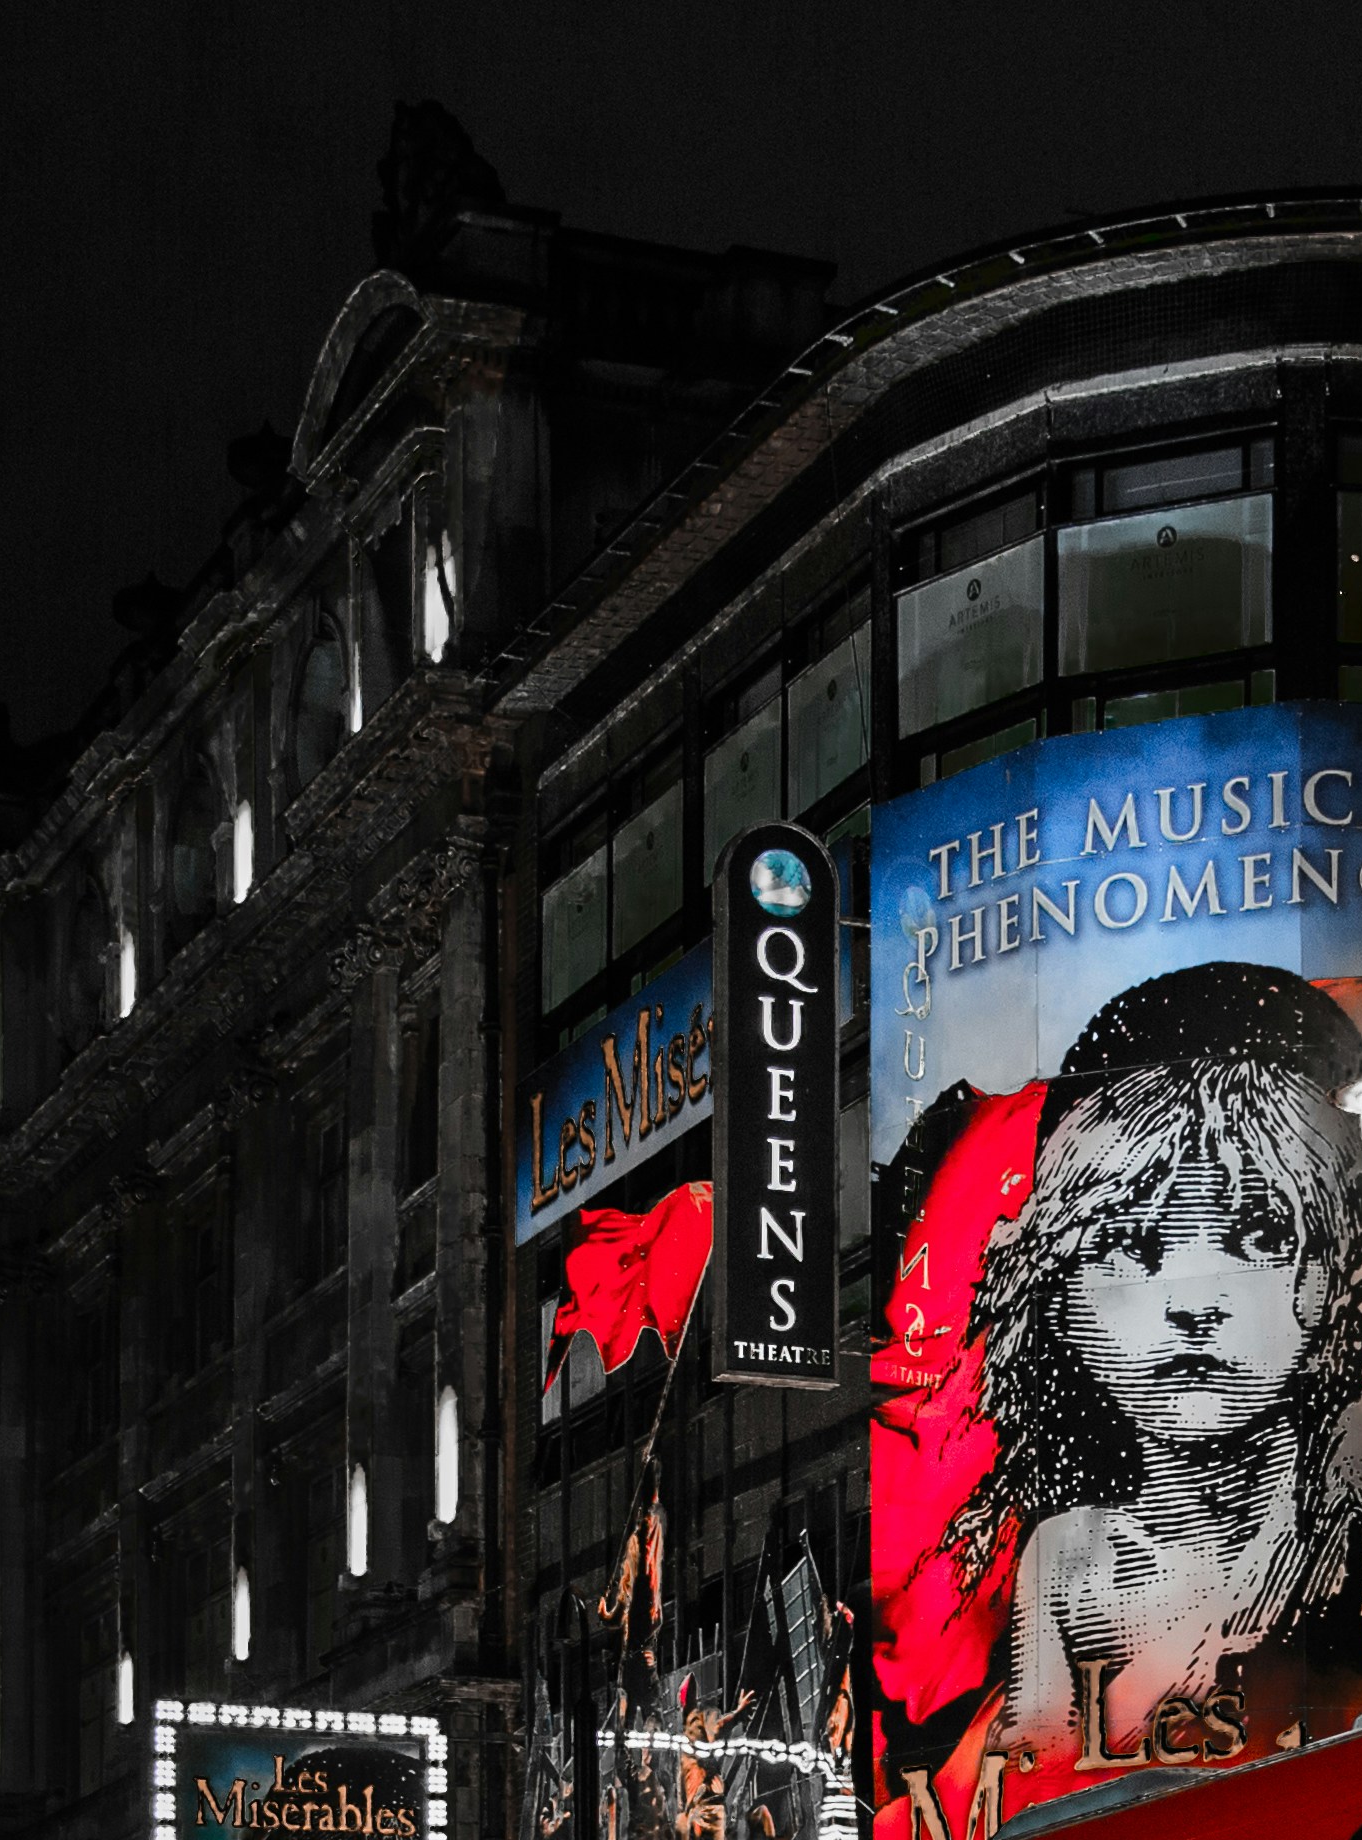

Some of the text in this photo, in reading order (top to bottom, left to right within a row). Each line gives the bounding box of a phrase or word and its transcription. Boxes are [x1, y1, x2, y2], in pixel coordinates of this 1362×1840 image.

[930, 807, 1041, 901] THE
[530, 1091, 596, 1212] Les
[756, 926, 819, 1333] QUEENS
[733, 1340, 831, 1367] THEATRE
[1075, 1657, 1250, 1772] Les
[273, 1754, 328, 1794] Les
